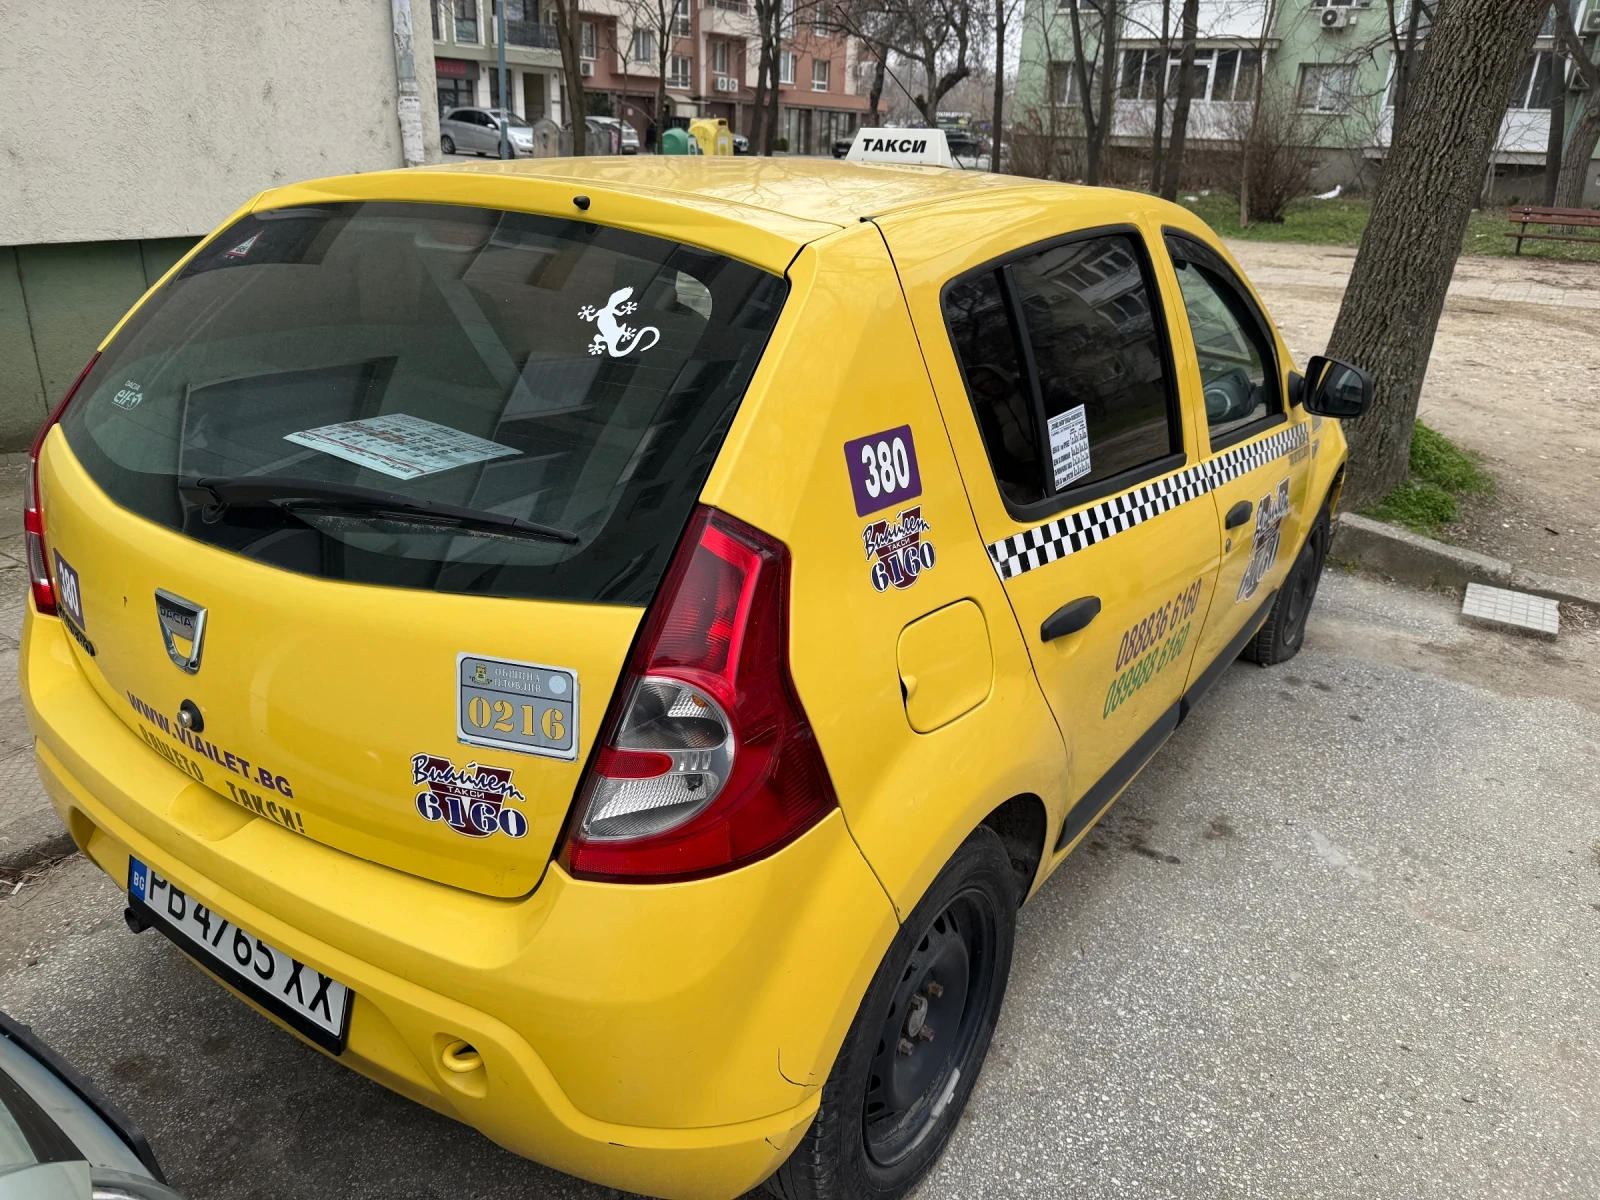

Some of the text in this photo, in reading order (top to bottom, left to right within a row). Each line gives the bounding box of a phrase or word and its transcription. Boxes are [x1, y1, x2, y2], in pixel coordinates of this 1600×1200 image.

[863, 138, 927, 153] ТАКСИ
[861, 436, 910, 498] 380
[871, 541, 935, 592] 6160
[887, 538, 911, 552] ТАКСИ
[59, 561, 80, 617] 380
[159, 606, 193, 629] DACIA
[1115, 577, 1202, 673] 088836 6160
[494, 678, 542, 693] ПЛОВДИВ
[1103, 620, 1191, 720] 089988 6160
[468, 696, 566, 740] 0216
[126, 690, 294, 799] WWW.VIAILET.BG
[225, 780, 306, 834] ТАКСИ!
[416, 791, 528, 838] 6160
[447, 785, 485, 800] ТАКСИ
[133, 871, 145, 891] BG
[149, 870, 187, 921] PB
[283, 958, 333, 1023] XX
